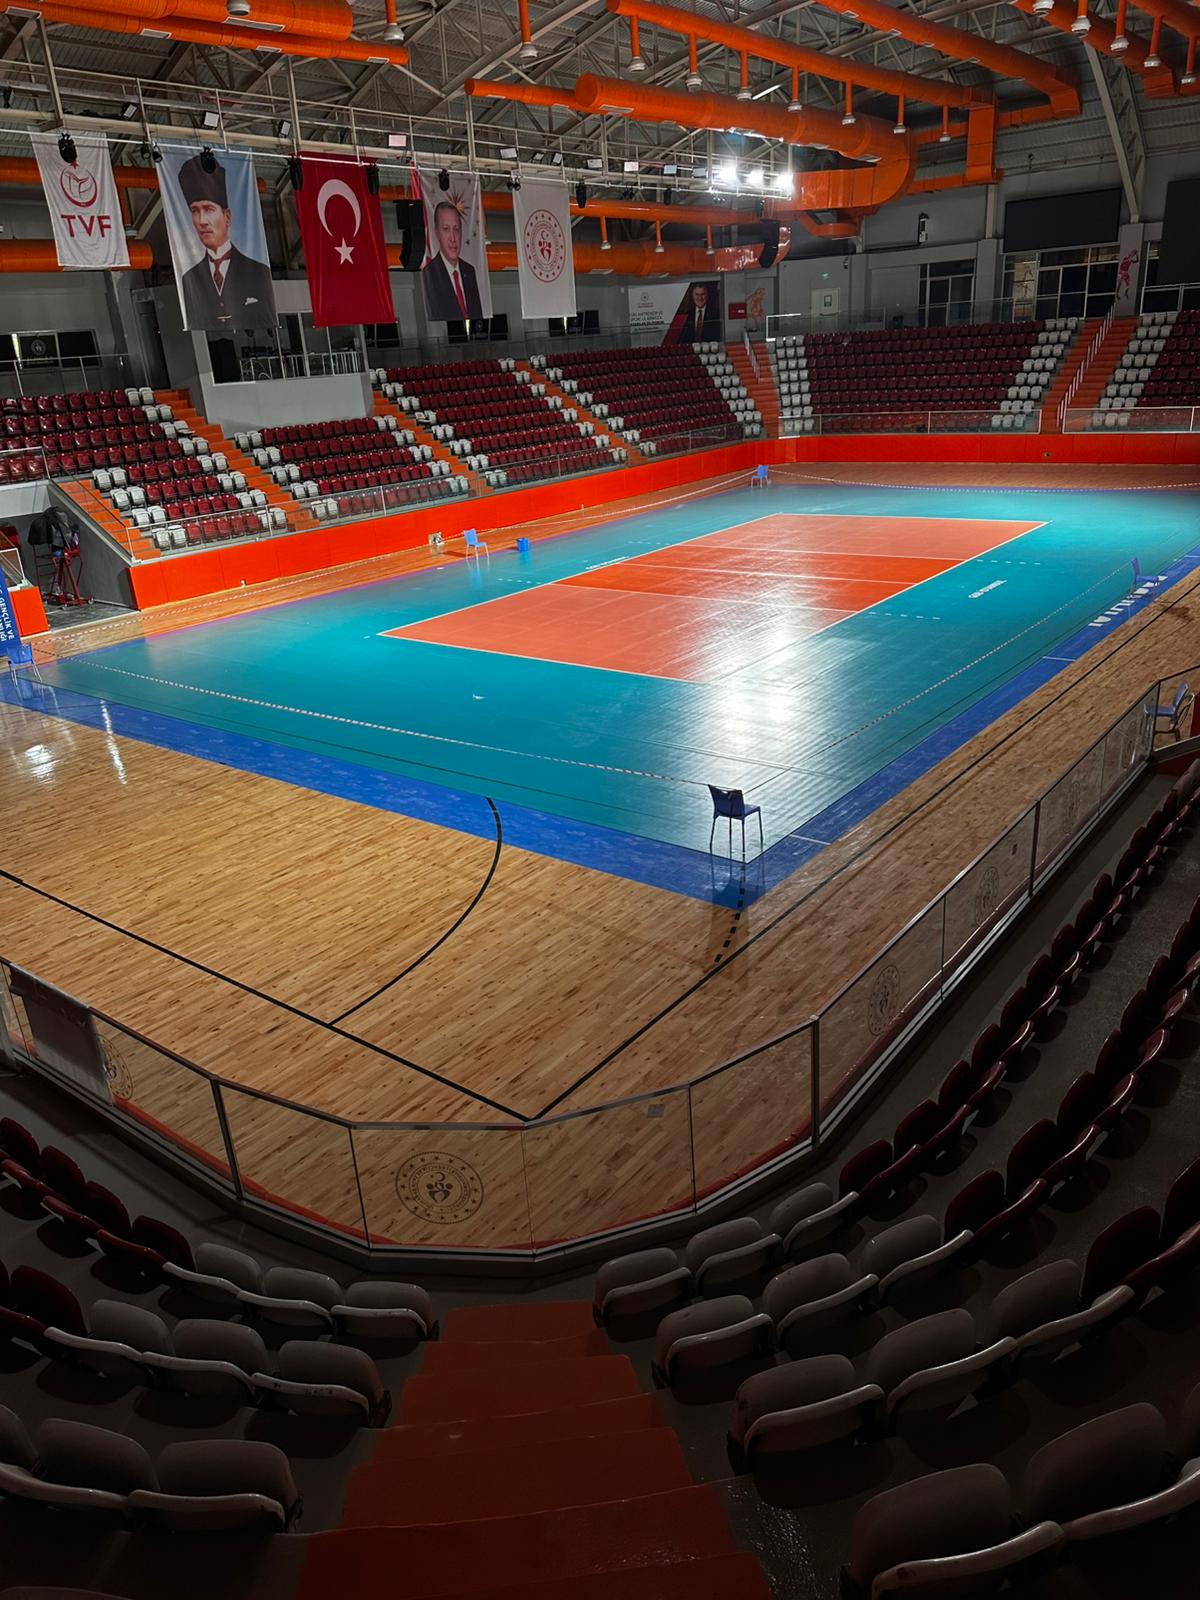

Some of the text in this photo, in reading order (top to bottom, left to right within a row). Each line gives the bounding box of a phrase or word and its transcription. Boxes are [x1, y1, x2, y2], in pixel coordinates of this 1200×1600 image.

[60, 213, 112, 238] TVF
[0, 597, 15, 640] GENÇLİK VE
